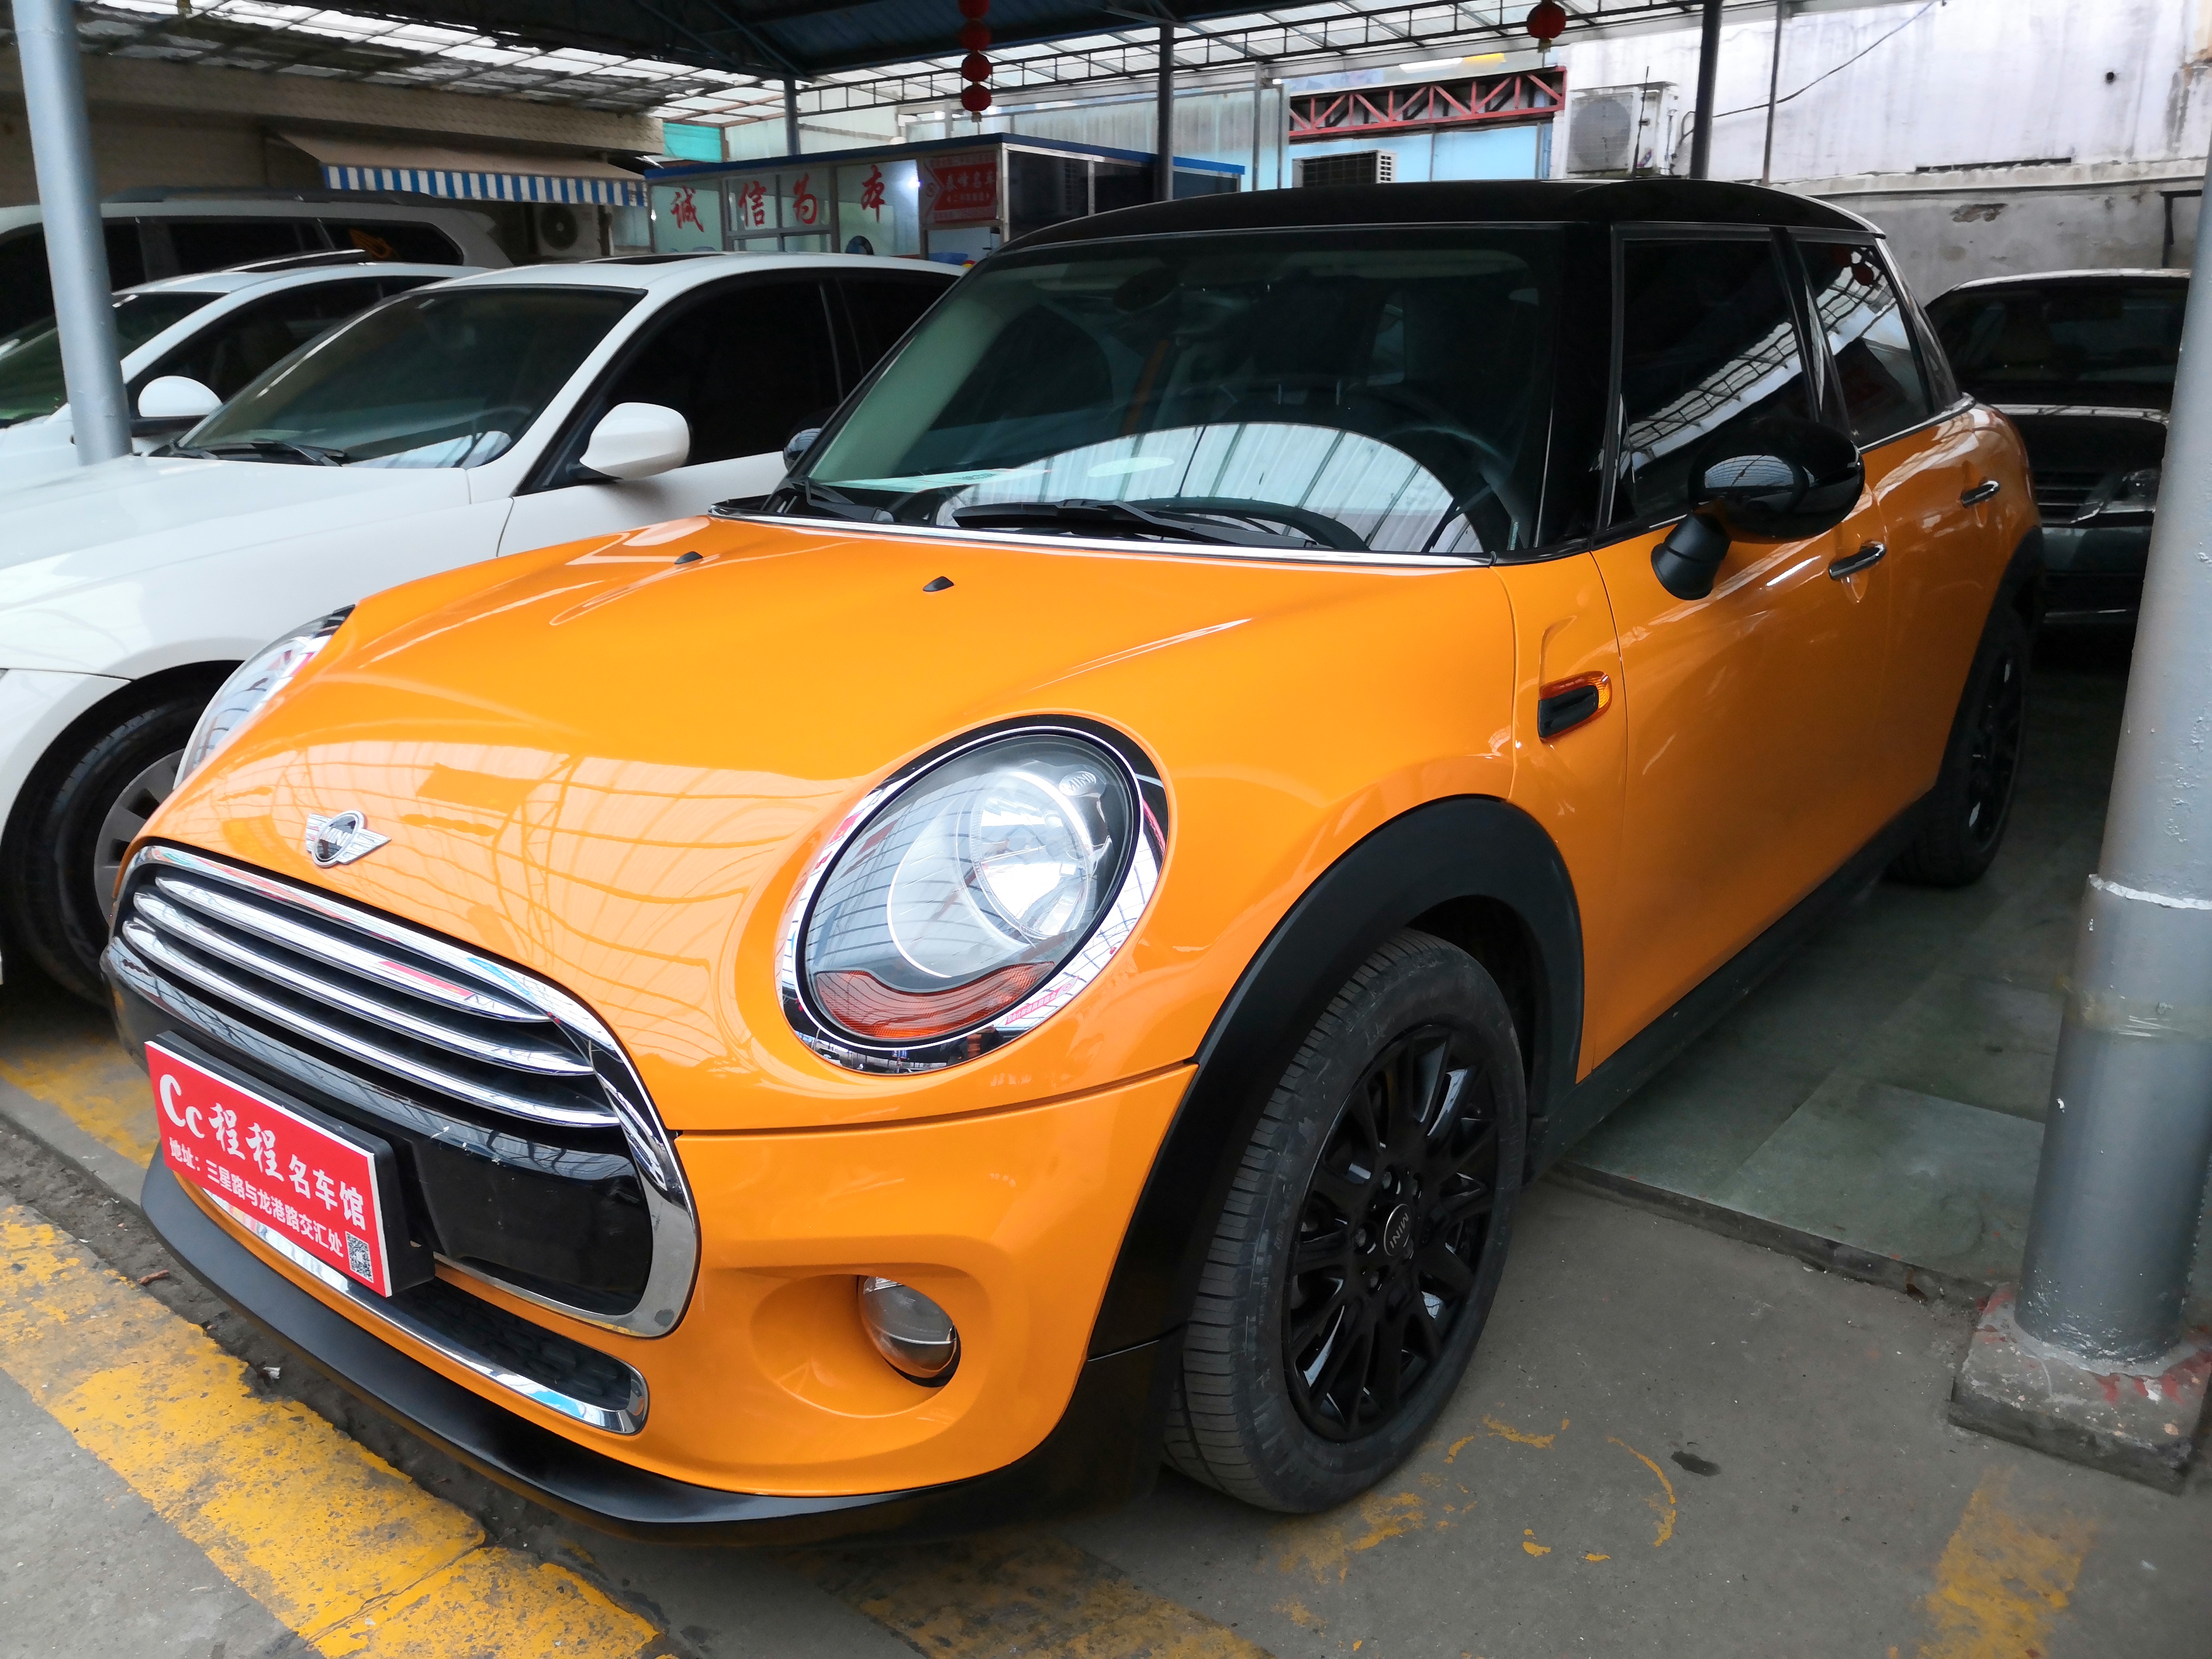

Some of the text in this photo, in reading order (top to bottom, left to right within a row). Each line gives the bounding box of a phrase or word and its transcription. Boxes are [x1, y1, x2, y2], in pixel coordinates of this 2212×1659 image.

[671, 164, 885, 232] 诚信为本
[319, 826, 352, 847] MINI
[208, 1103, 366, 1231] 程程名车馆
[1389, 1212, 1409, 1249] MINI
